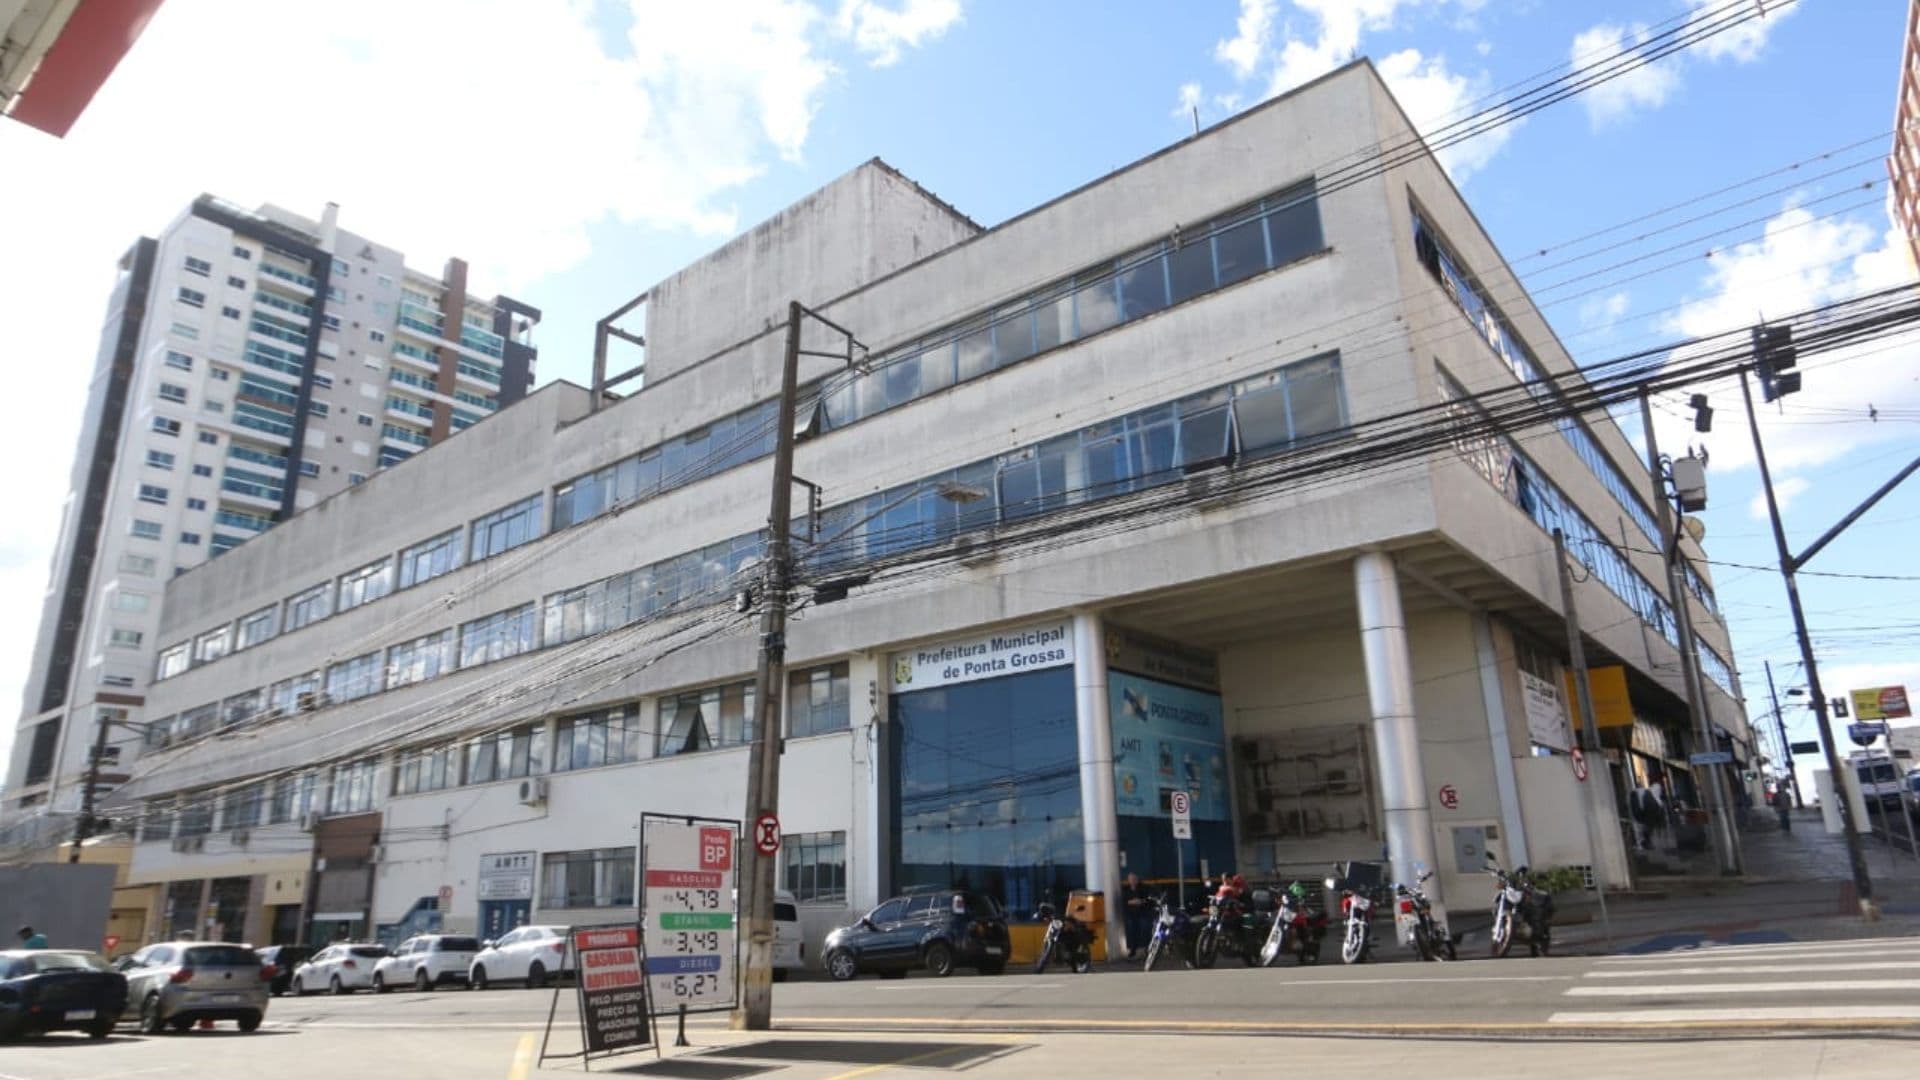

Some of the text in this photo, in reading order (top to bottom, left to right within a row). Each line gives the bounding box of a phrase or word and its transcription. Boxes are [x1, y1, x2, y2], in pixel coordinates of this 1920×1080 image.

[917, 625, 1065, 667] Prefeitura Municipal
[943, 648, 1066, 680] de Ponta Grossa
[704, 845, 727, 864] BP
[669, 873, 718, 884] GASOLINA
[676, 889, 719, 911] 4,79
[676, 931, 719, 953] 3,49
[680, 957, 714, 969] DIESEL
[674, 974, 718, 999] 6,27
[589, 994, 611, 1008] PELO
[597, 1006, 625, 1019] PREÇO
[597, 1017, 641, 1032] GASOLINA
